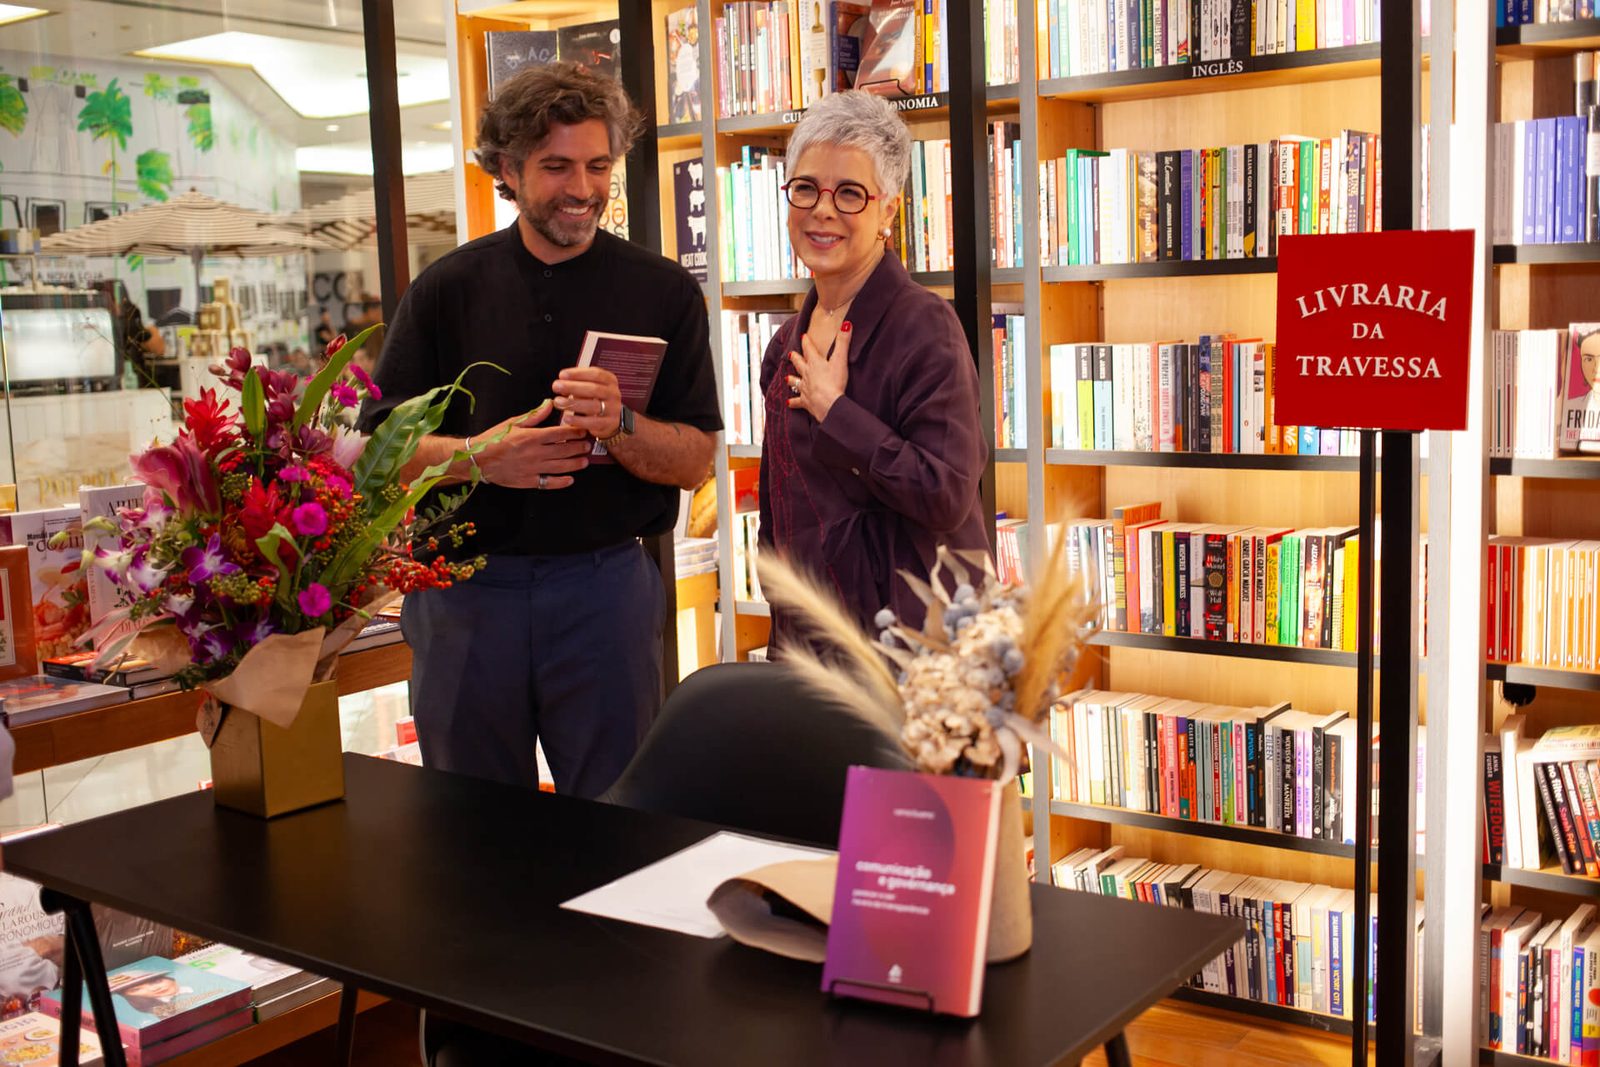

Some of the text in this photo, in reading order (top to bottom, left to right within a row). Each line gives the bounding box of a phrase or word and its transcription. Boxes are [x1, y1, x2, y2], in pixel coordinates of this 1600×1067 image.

[1192, 60, 1243, 77] INGLÊS
[891, 96, 938, 111] ONOMIA
[1296, 283, 1447, 321] LIVRARIA
[1352, 323, 1384, 339] DA
[1296, 356, 1442, 378] TRAVESSA
[1488, 780, 1503, 847] WIFEDOM
[1548, 765, 1577, 854] no filter Sarah Frier
[2, 912, 46, 931] LAROUS
